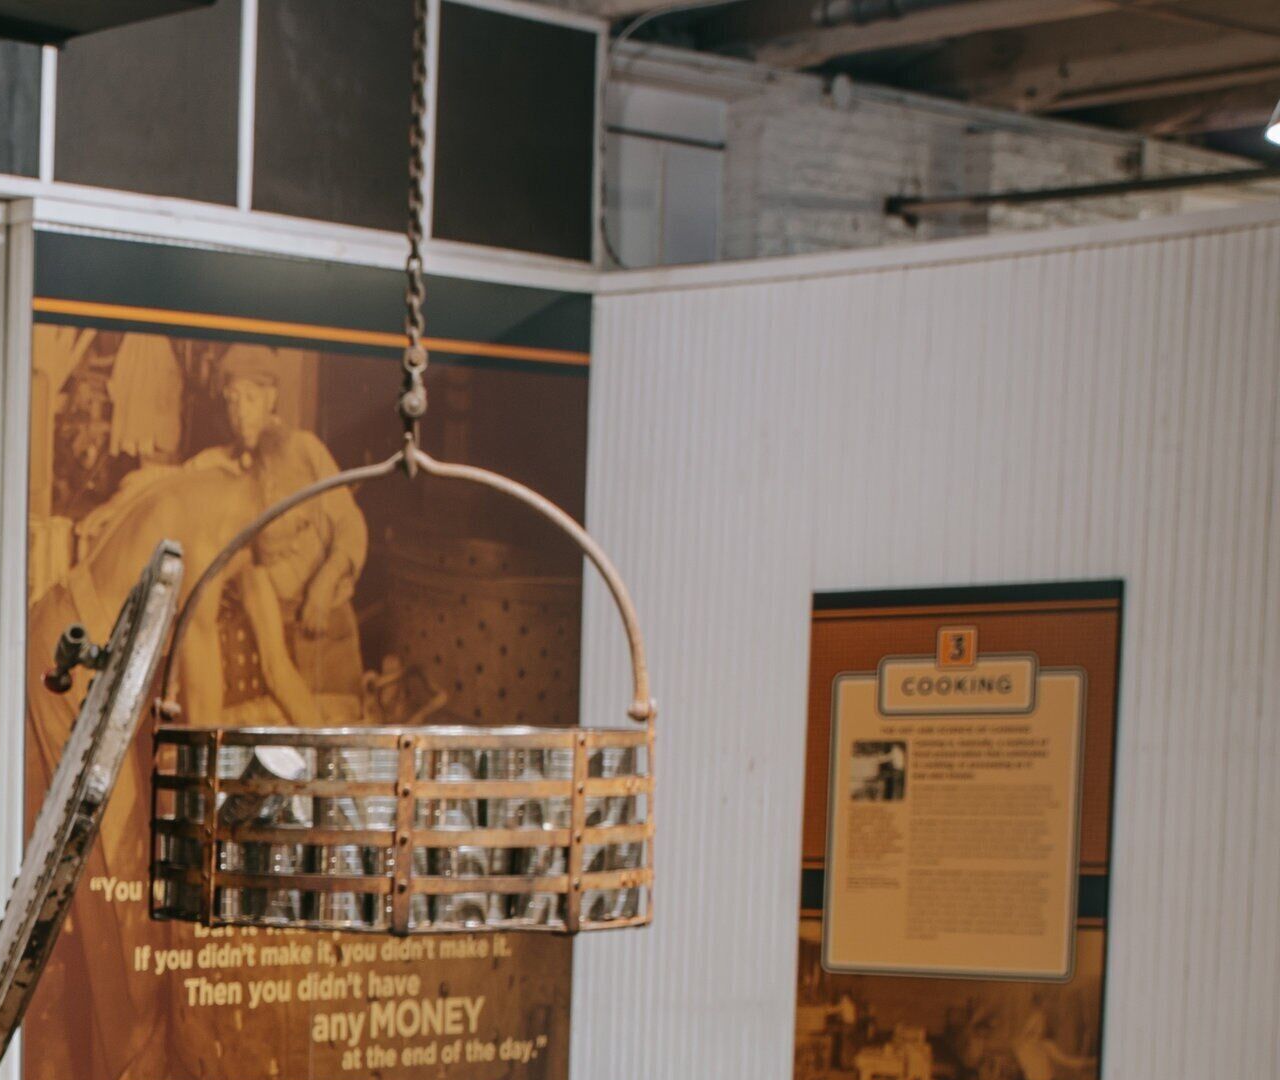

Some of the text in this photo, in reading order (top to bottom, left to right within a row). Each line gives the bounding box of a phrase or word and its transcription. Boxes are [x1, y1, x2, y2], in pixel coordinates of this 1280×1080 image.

[949, 633, 966, 661] 3
[900, 673, 1013, 697] COOKING
[89, 876, 143, 903] “You
[133, 934, 512, 976] If you didn’t make it, you didn’t make it.
[182, 969, 421, 1009] Then you didn’t have
[310, 994, 485, 1047] any MONEY
[340, 1035, 547, 1071] at the end of the day.”
